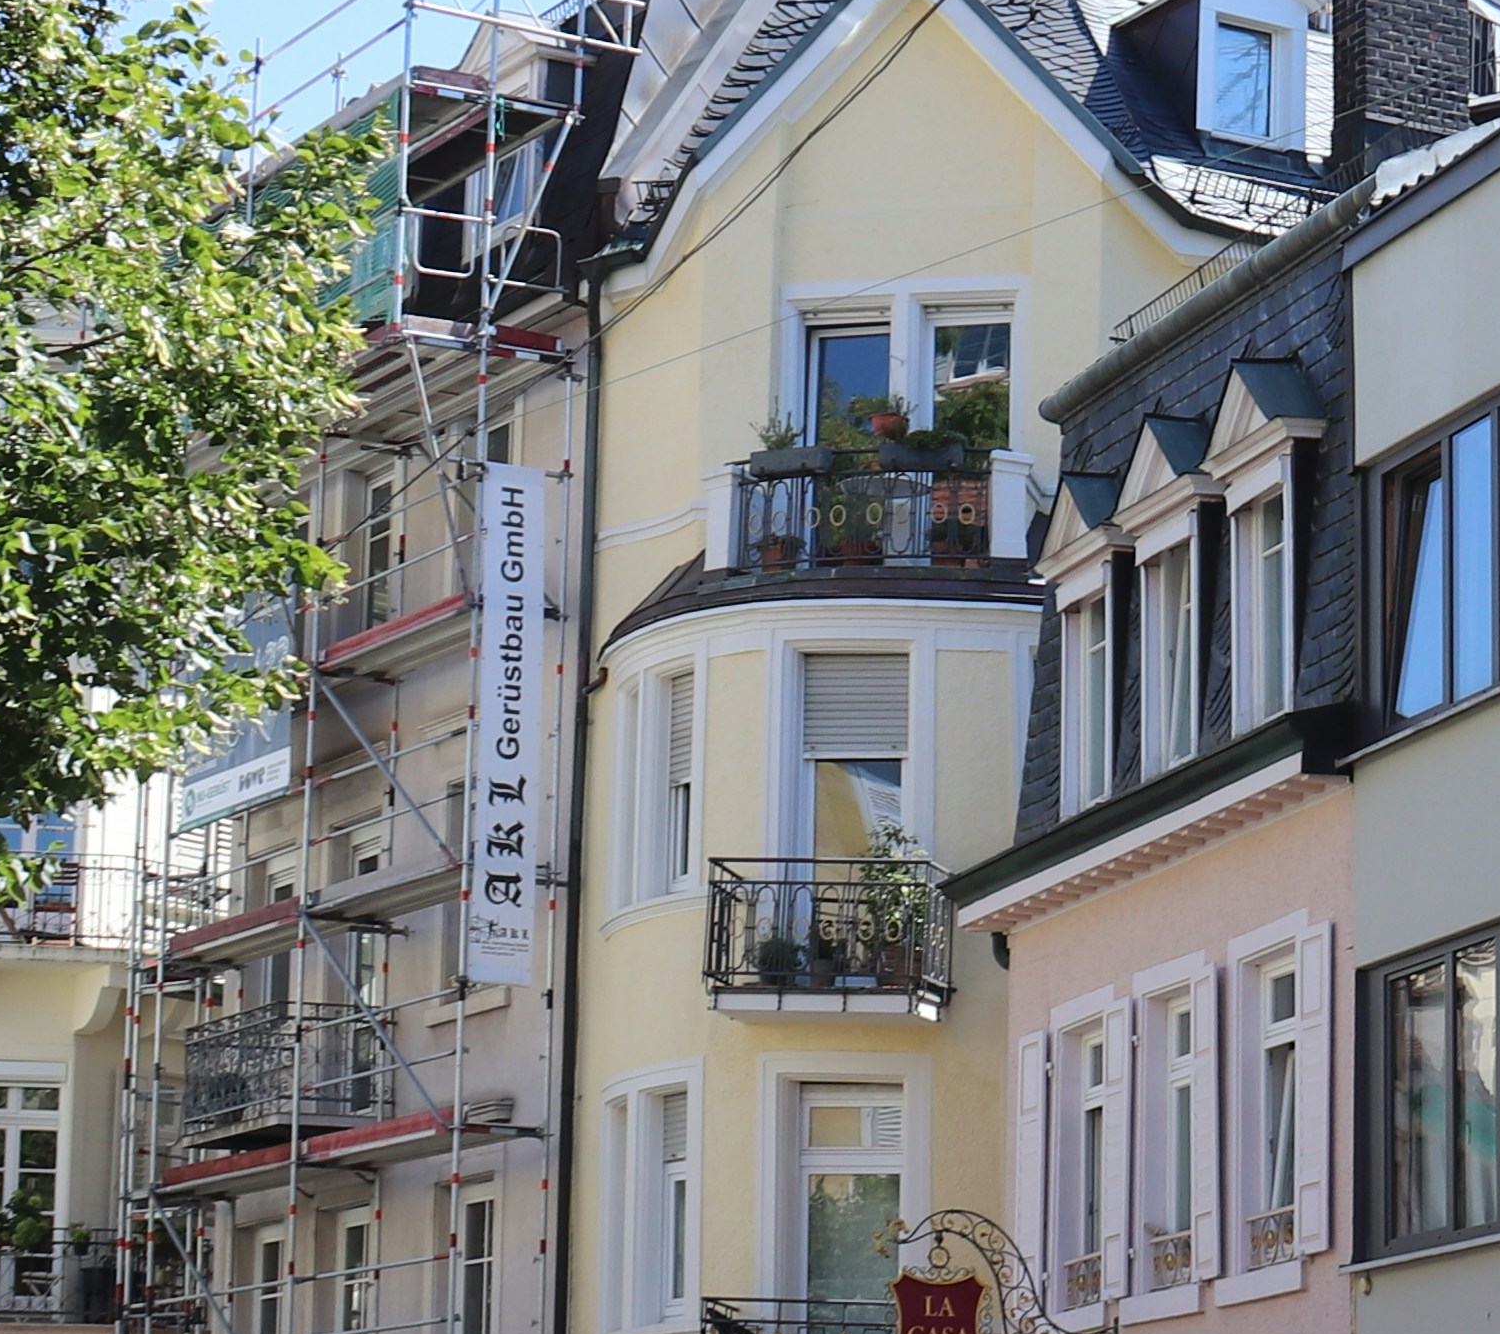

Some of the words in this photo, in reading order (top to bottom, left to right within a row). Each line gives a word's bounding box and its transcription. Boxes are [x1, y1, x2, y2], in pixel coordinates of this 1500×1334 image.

[500, 487, 525, 583] GmbH
[496, 594, 525, 760] Gerüstbau
[924, 1295, 955, 1317] LA
